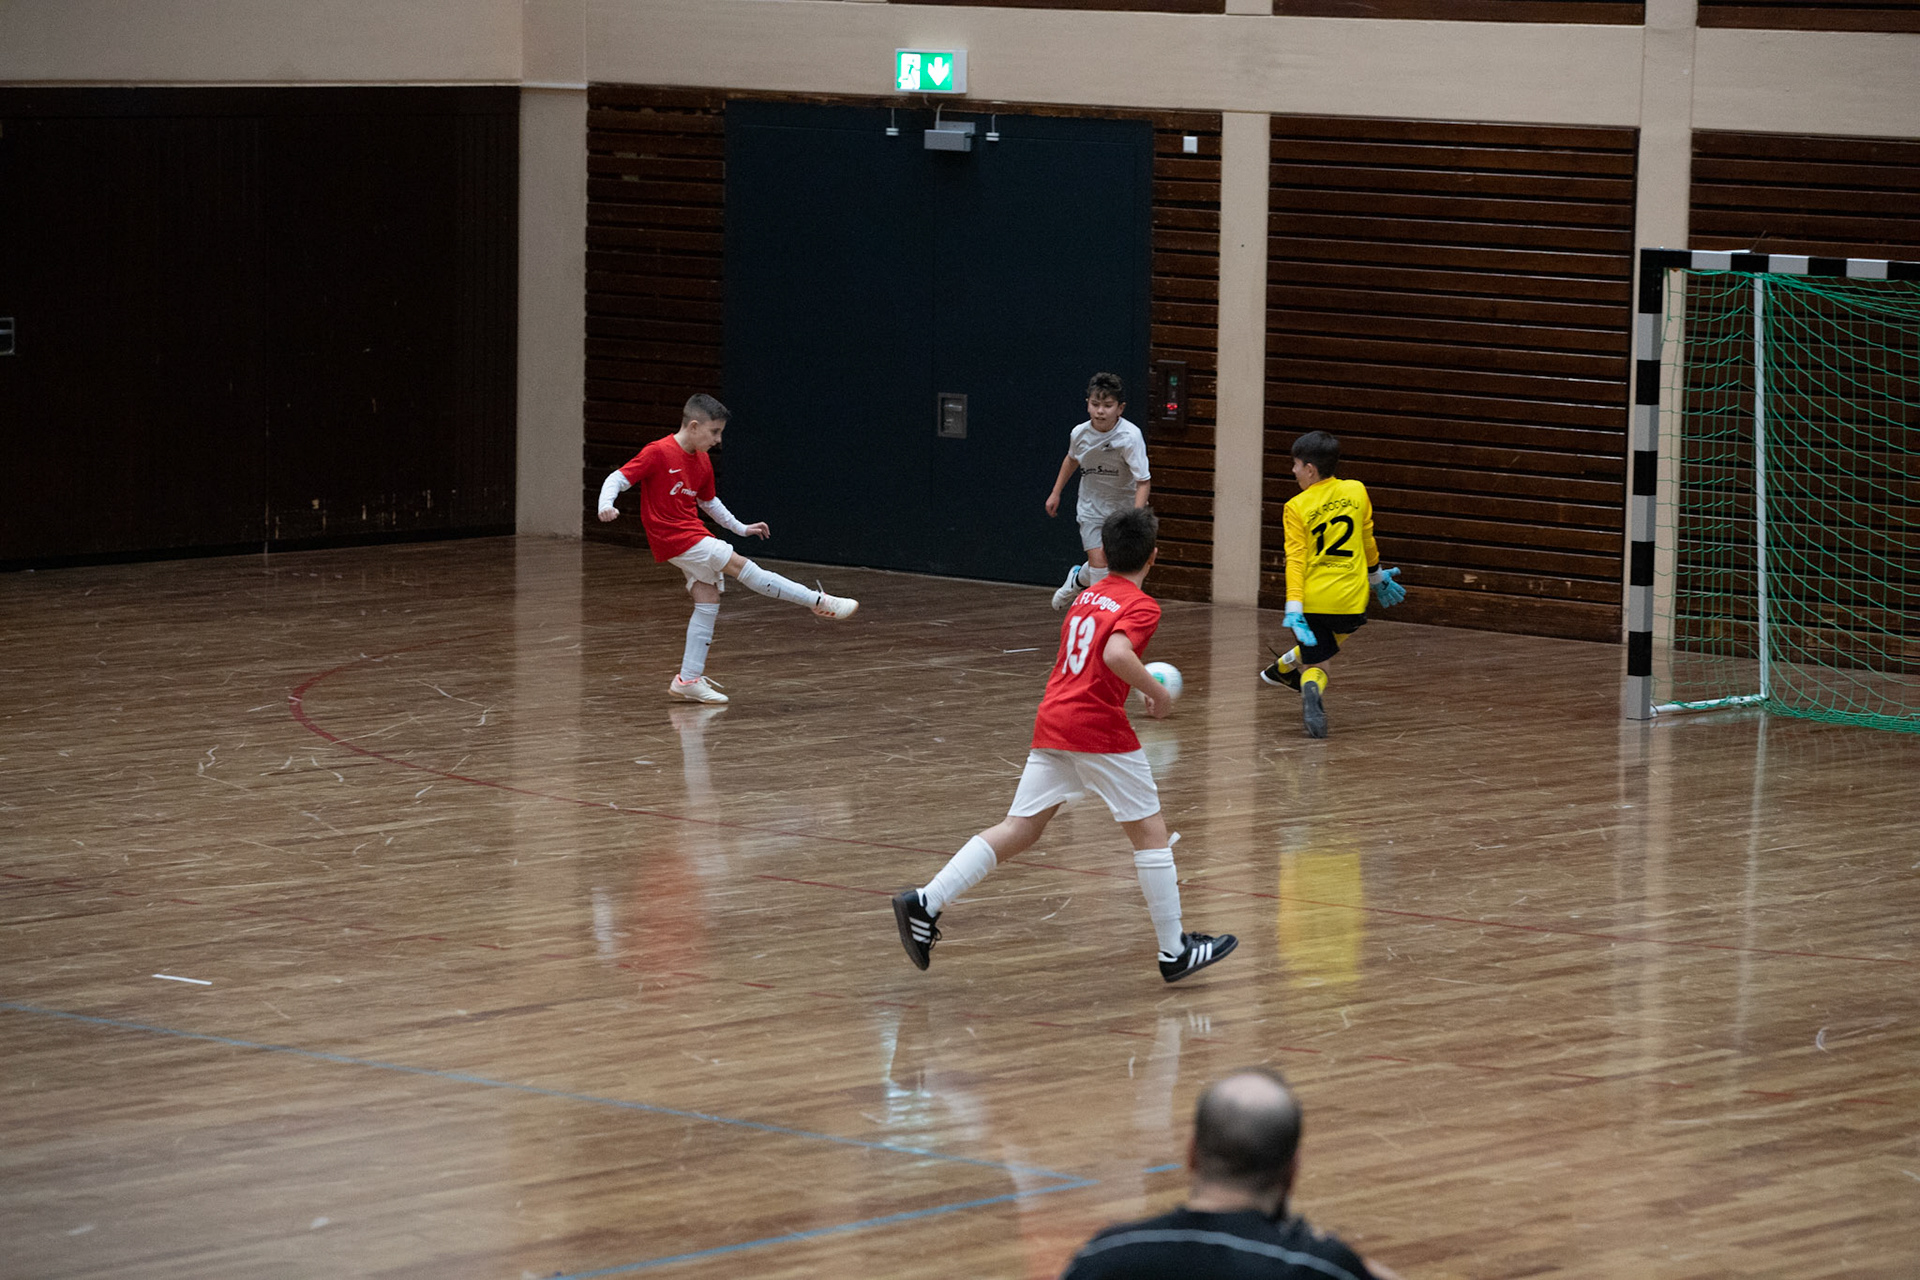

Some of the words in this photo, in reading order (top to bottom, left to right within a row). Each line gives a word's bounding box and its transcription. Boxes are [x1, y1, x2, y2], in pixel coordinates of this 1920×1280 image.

[1312, 515, 1354, 557] 12
[1080, 592, 1094, 604] FC
[1062, 616, 1095, 674] 13
